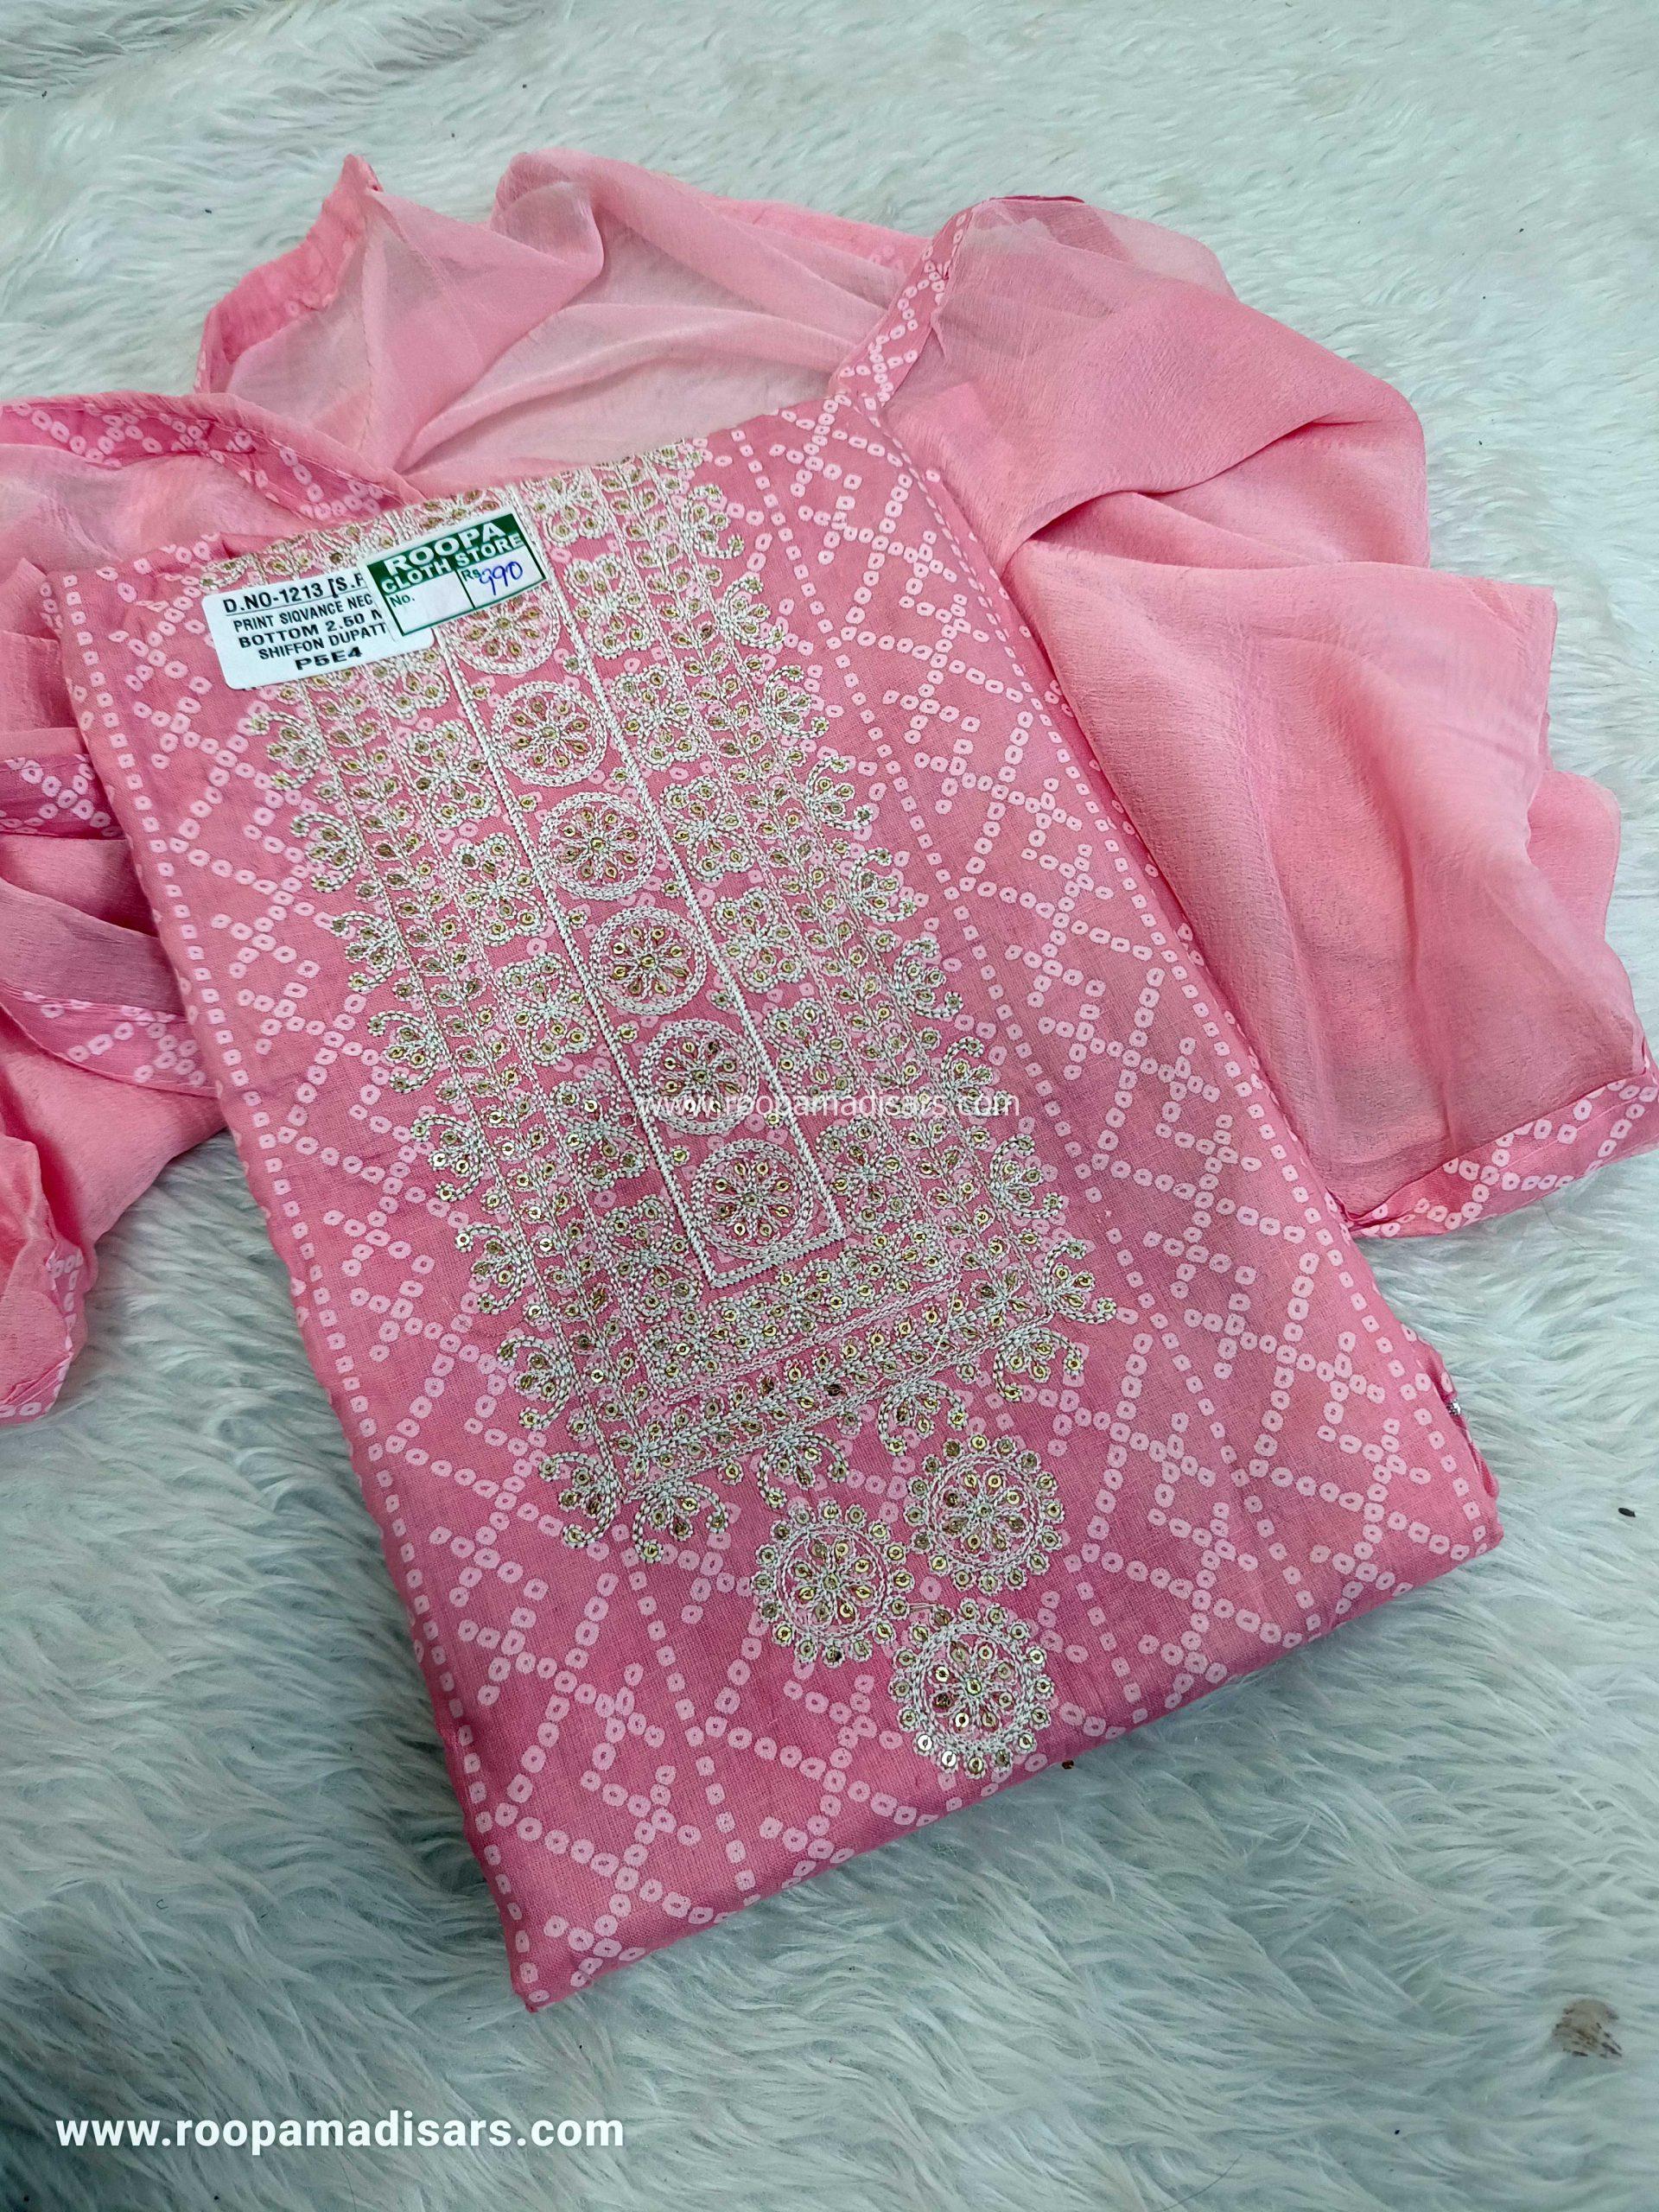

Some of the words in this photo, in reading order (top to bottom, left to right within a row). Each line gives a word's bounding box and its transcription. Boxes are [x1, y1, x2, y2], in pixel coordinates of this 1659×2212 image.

[381, 558, 452, 594] CLOTH
[454, 531, 524, 567] STORE
[384, 522, 506, 576] ROOPA
[223, 582, 324, 613] D.NO-1213
[390, 593, 415, 607] No.
[232, 614, 274, 632] PRINT
[238, 623, 320, 648] BOTTOM
[325, 613, 365, 632] 2.50
[258, 637, 325, 660] SHIFFON
[328, 622, 387, 647] DUPATT
[295, 645, 363, 671] P5E4
